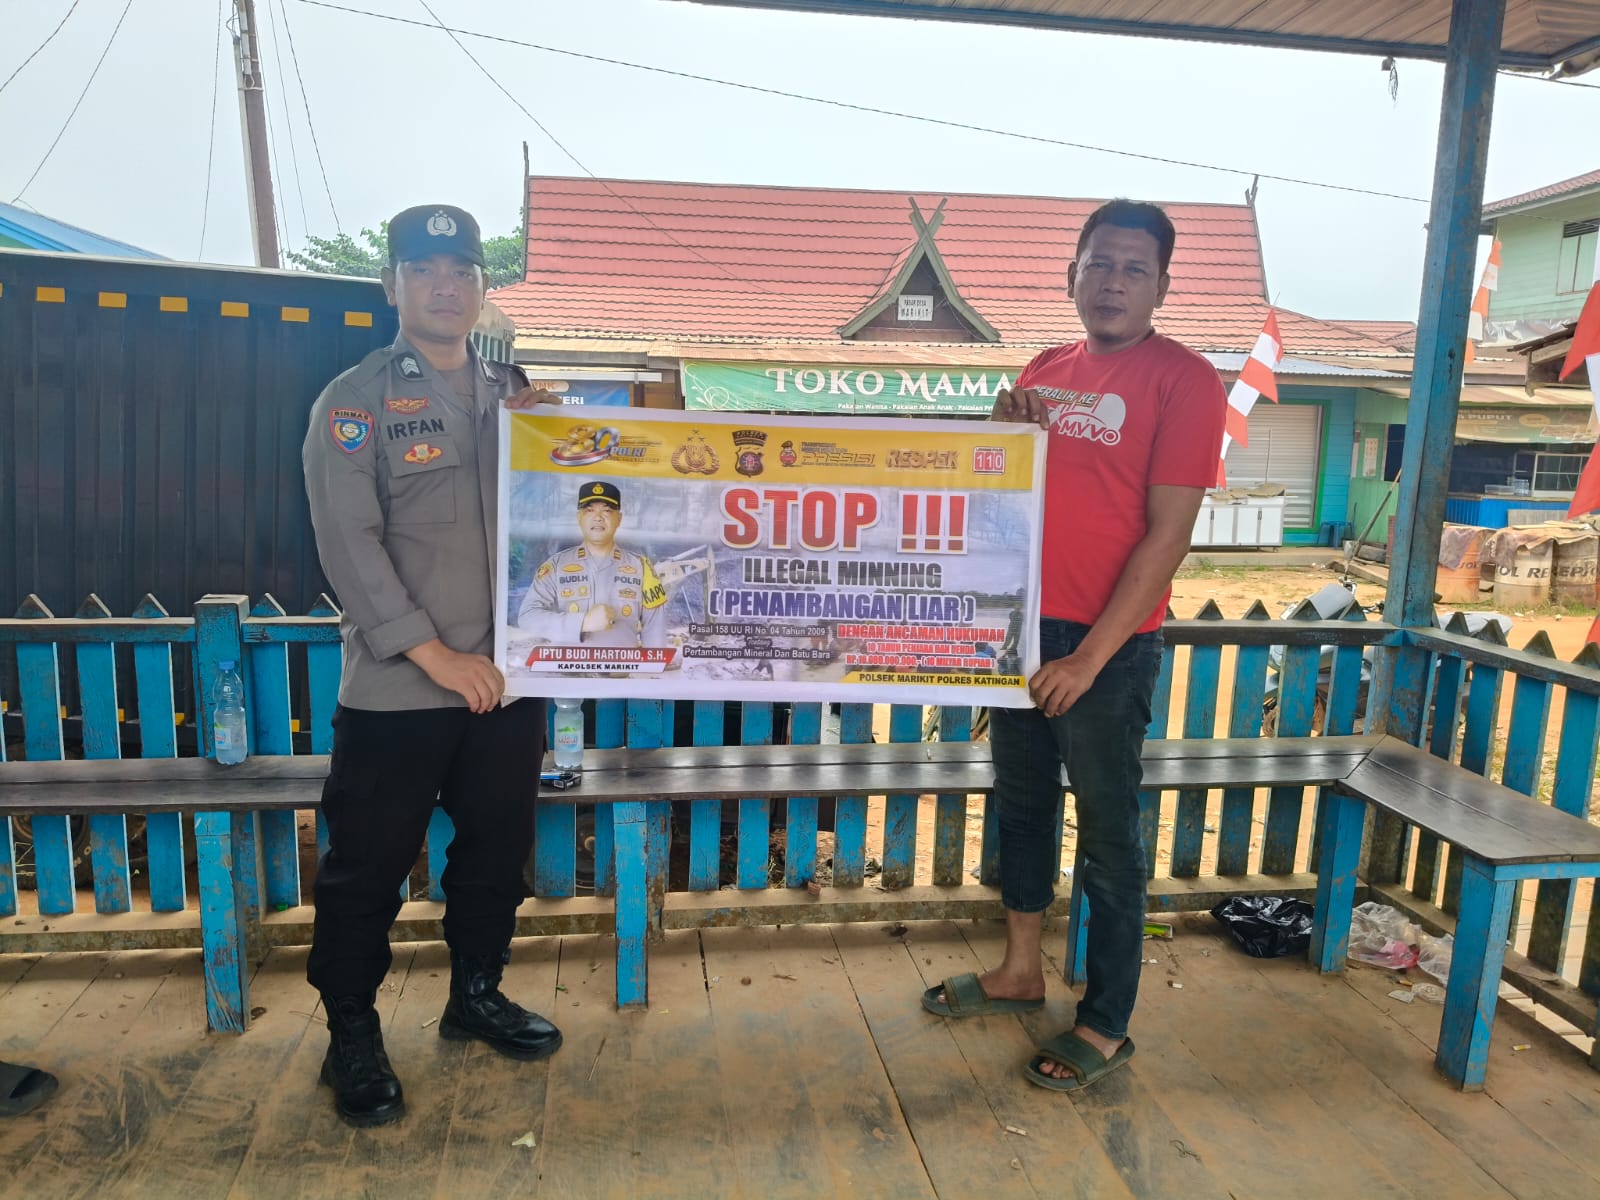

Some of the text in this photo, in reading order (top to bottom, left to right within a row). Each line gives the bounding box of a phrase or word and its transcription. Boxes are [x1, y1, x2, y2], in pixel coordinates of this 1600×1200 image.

[765, 367, 885, 396] TOKO
[1078, 391, 1098, 405] KE
[386, 418, 445, 441] IRFAN
[975, 452, 1003, 470] 110
[721, 487, 967, 553] STOP !!!
[614, 575, 641, 586] POLRI
[744, 557, 943, 588] ILLEGAL MINNING
[690, 624, 714, 633] Pasal
[715, 624, 729, 634] 158
[730, 625, 743, 634] UU
[744, 625, 753, 634] RI
[770, 626, 780, 634] 04
[782, 626, 806, 636] Tahun
[807, 626, 826, 636] 2009
[837, 624, 1006, 643] DENGAN ANCAMAN HUKUMAN
[539, 648, 667, 662] IPTU BUDI HARTONO, S.H.
[683, 647, 831, 660] Pertambangan Mineral Dan Batu Bara
[859, 672, 1021, 687] POLSEK MARIKIT POLRES KATINGAN
